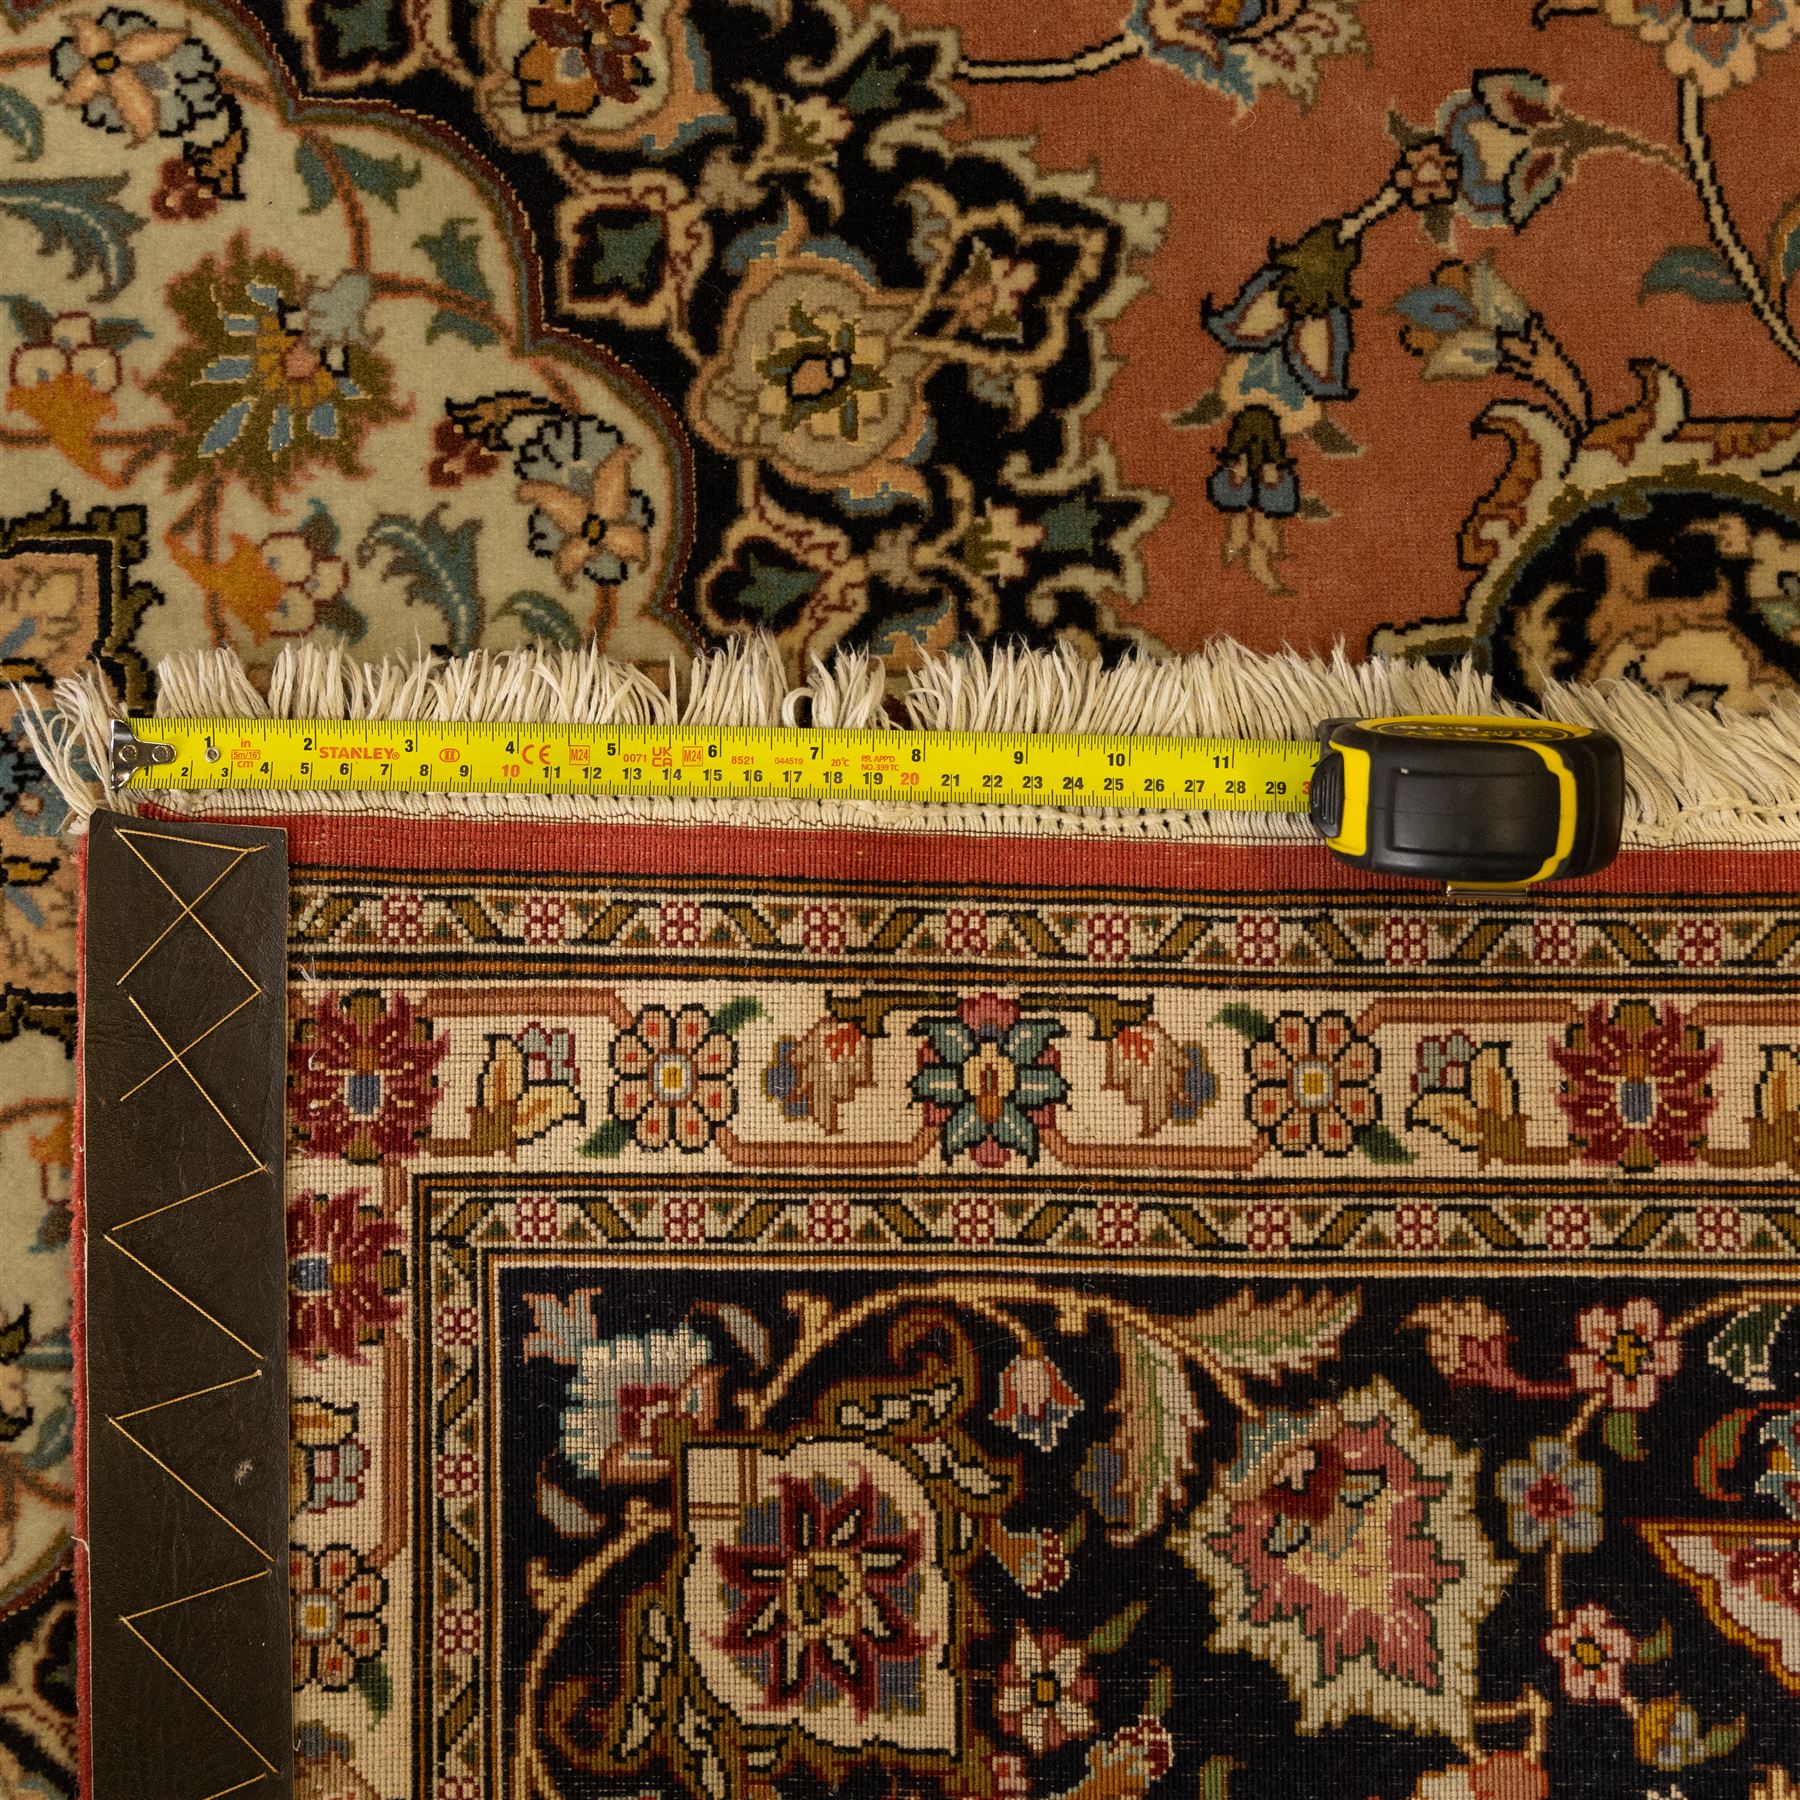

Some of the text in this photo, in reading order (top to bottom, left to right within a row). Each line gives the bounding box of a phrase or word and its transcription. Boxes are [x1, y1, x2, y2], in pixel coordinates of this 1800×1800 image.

[241, 739, 250, 747] in
[204, 736, 1229, 768] 1 2 3 4 5 6 7 8 9 10 11
[570, 750, 589, 761] M24
[652, 747, 672, 756] UK
[684, 750, 701, 762] M24
[623, 754, 647, 762] 0071
[652, 758, 672, 767] CA
[732, 756, 755, 765] 8521
[832, 758, 849, 767] 20°C
[144, 762, 1310, 794] 1 2 3 4 5 6 7 8 9 10 11 12 13 14 15 16 17 18 19 20 21 22 23 24 25 26 27 28 29 3
